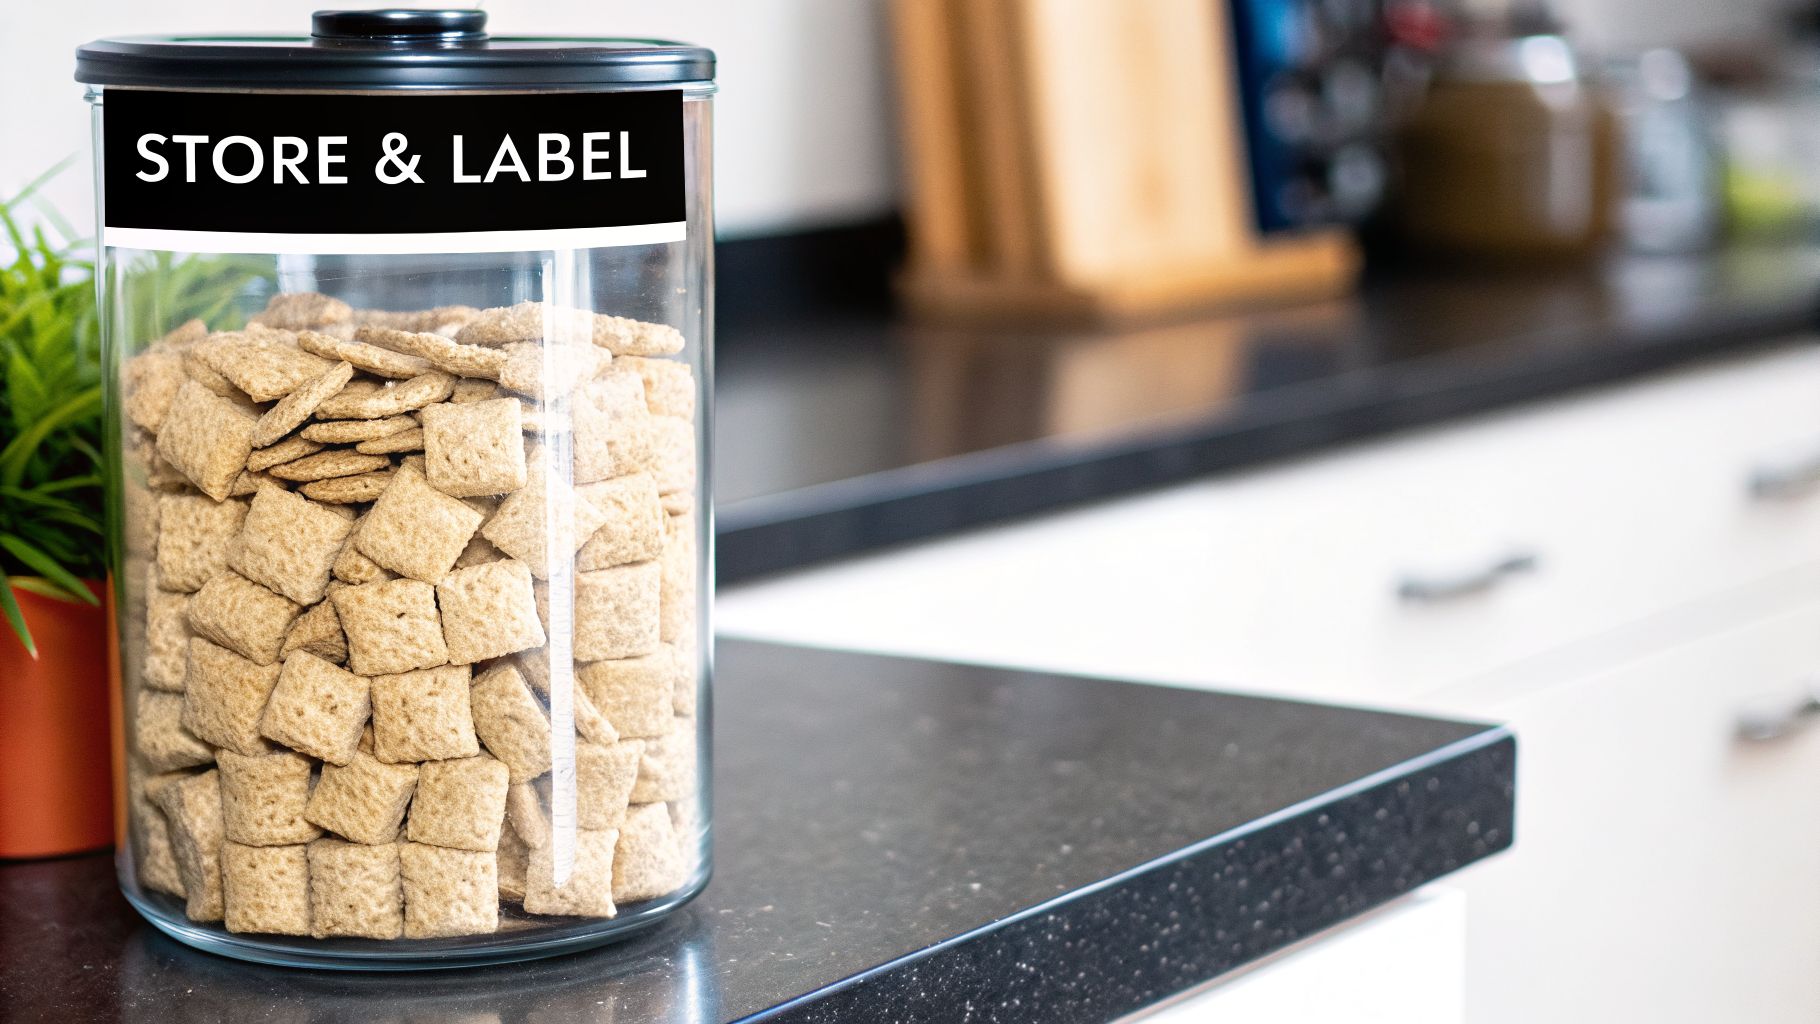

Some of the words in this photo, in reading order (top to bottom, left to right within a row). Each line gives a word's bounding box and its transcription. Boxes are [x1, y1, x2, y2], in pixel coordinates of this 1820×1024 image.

[135, 132, 348, 184] STORE
[374, 131, 425, 184] &
[453, 131, 647, 184] LABEL
